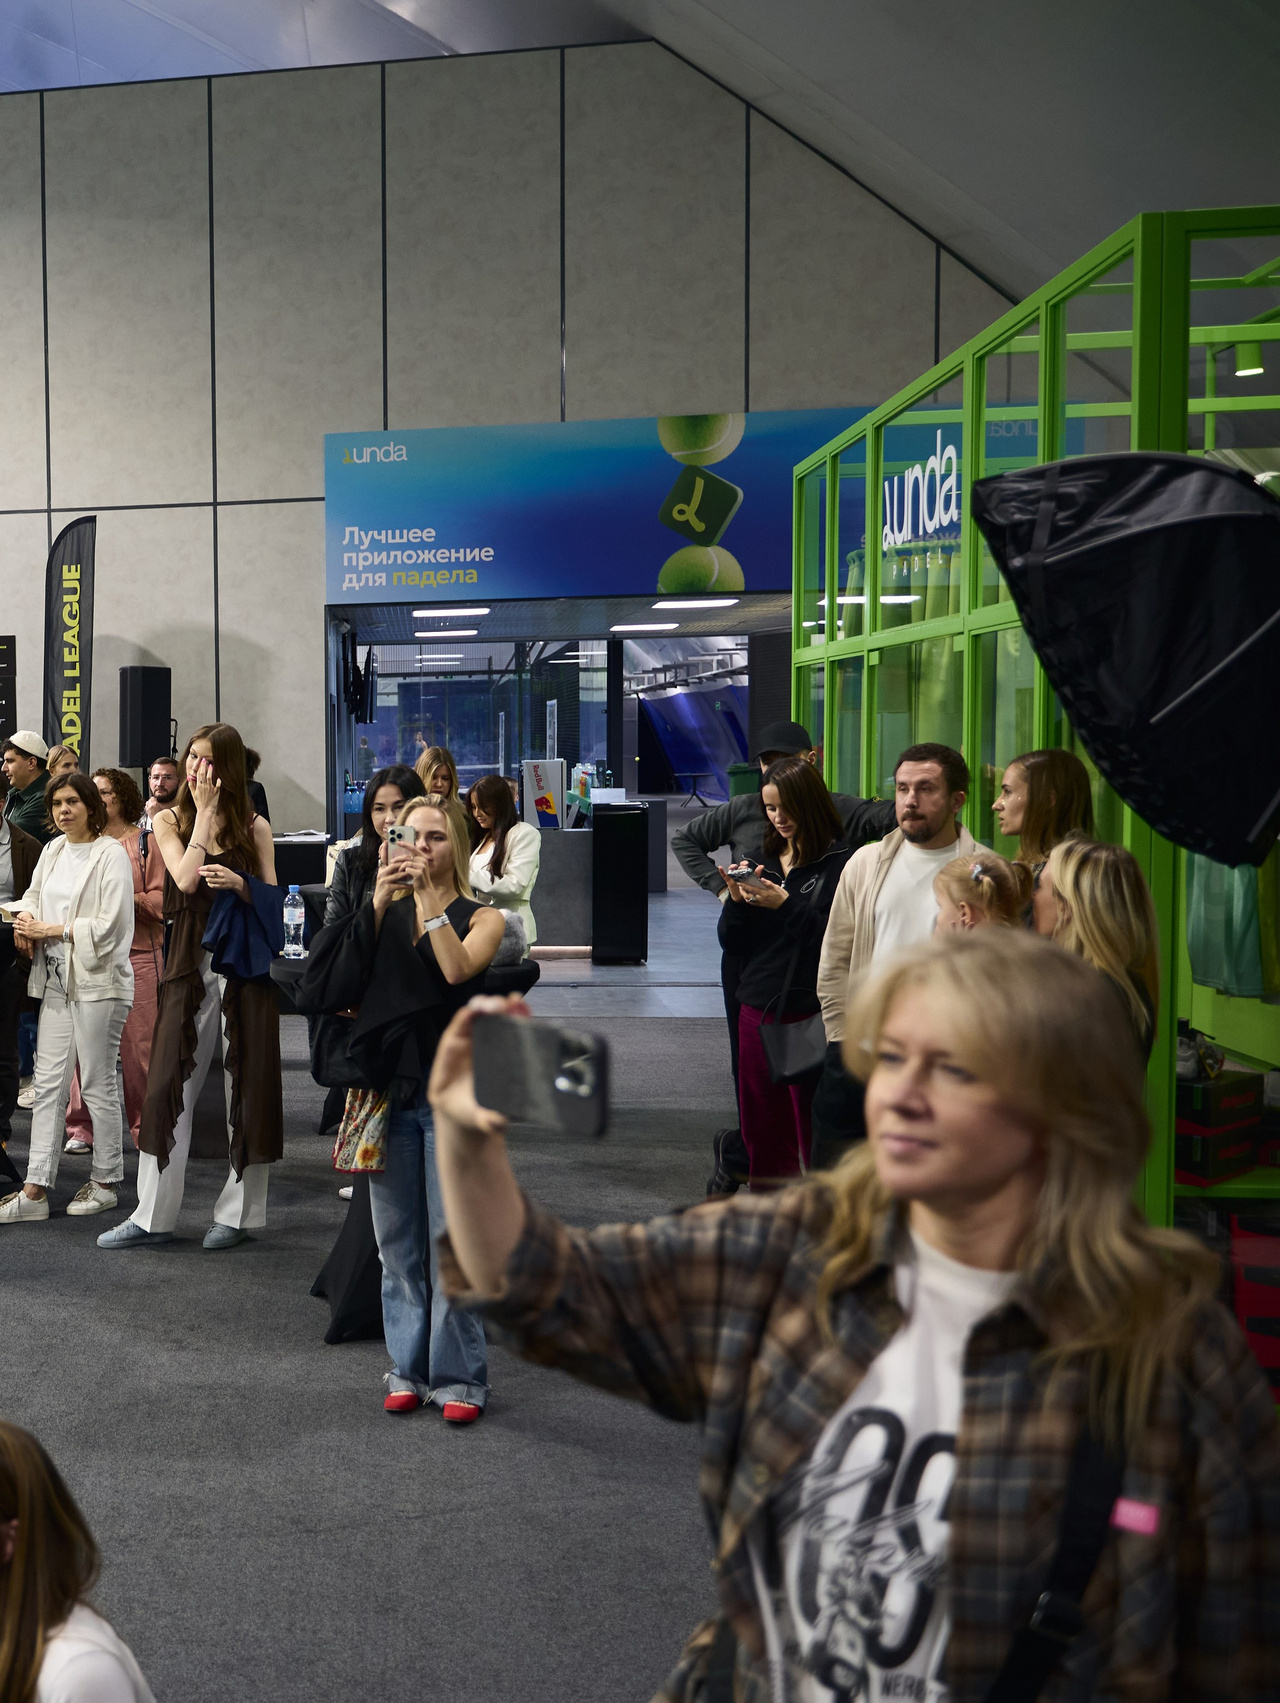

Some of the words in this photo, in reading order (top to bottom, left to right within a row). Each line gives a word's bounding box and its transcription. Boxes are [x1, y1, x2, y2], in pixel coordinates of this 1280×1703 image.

[342, 527, 436, 549] Лучшее
[343, 547, 494, 570] приложение
[892, 548, 943, 579] PADEL
[342, 572, 387, 591] для
[393, 569, 477, 588] падела
[62, 564, 81, 677] LEAGUE
[61, 683, 82, 757] ADEL
